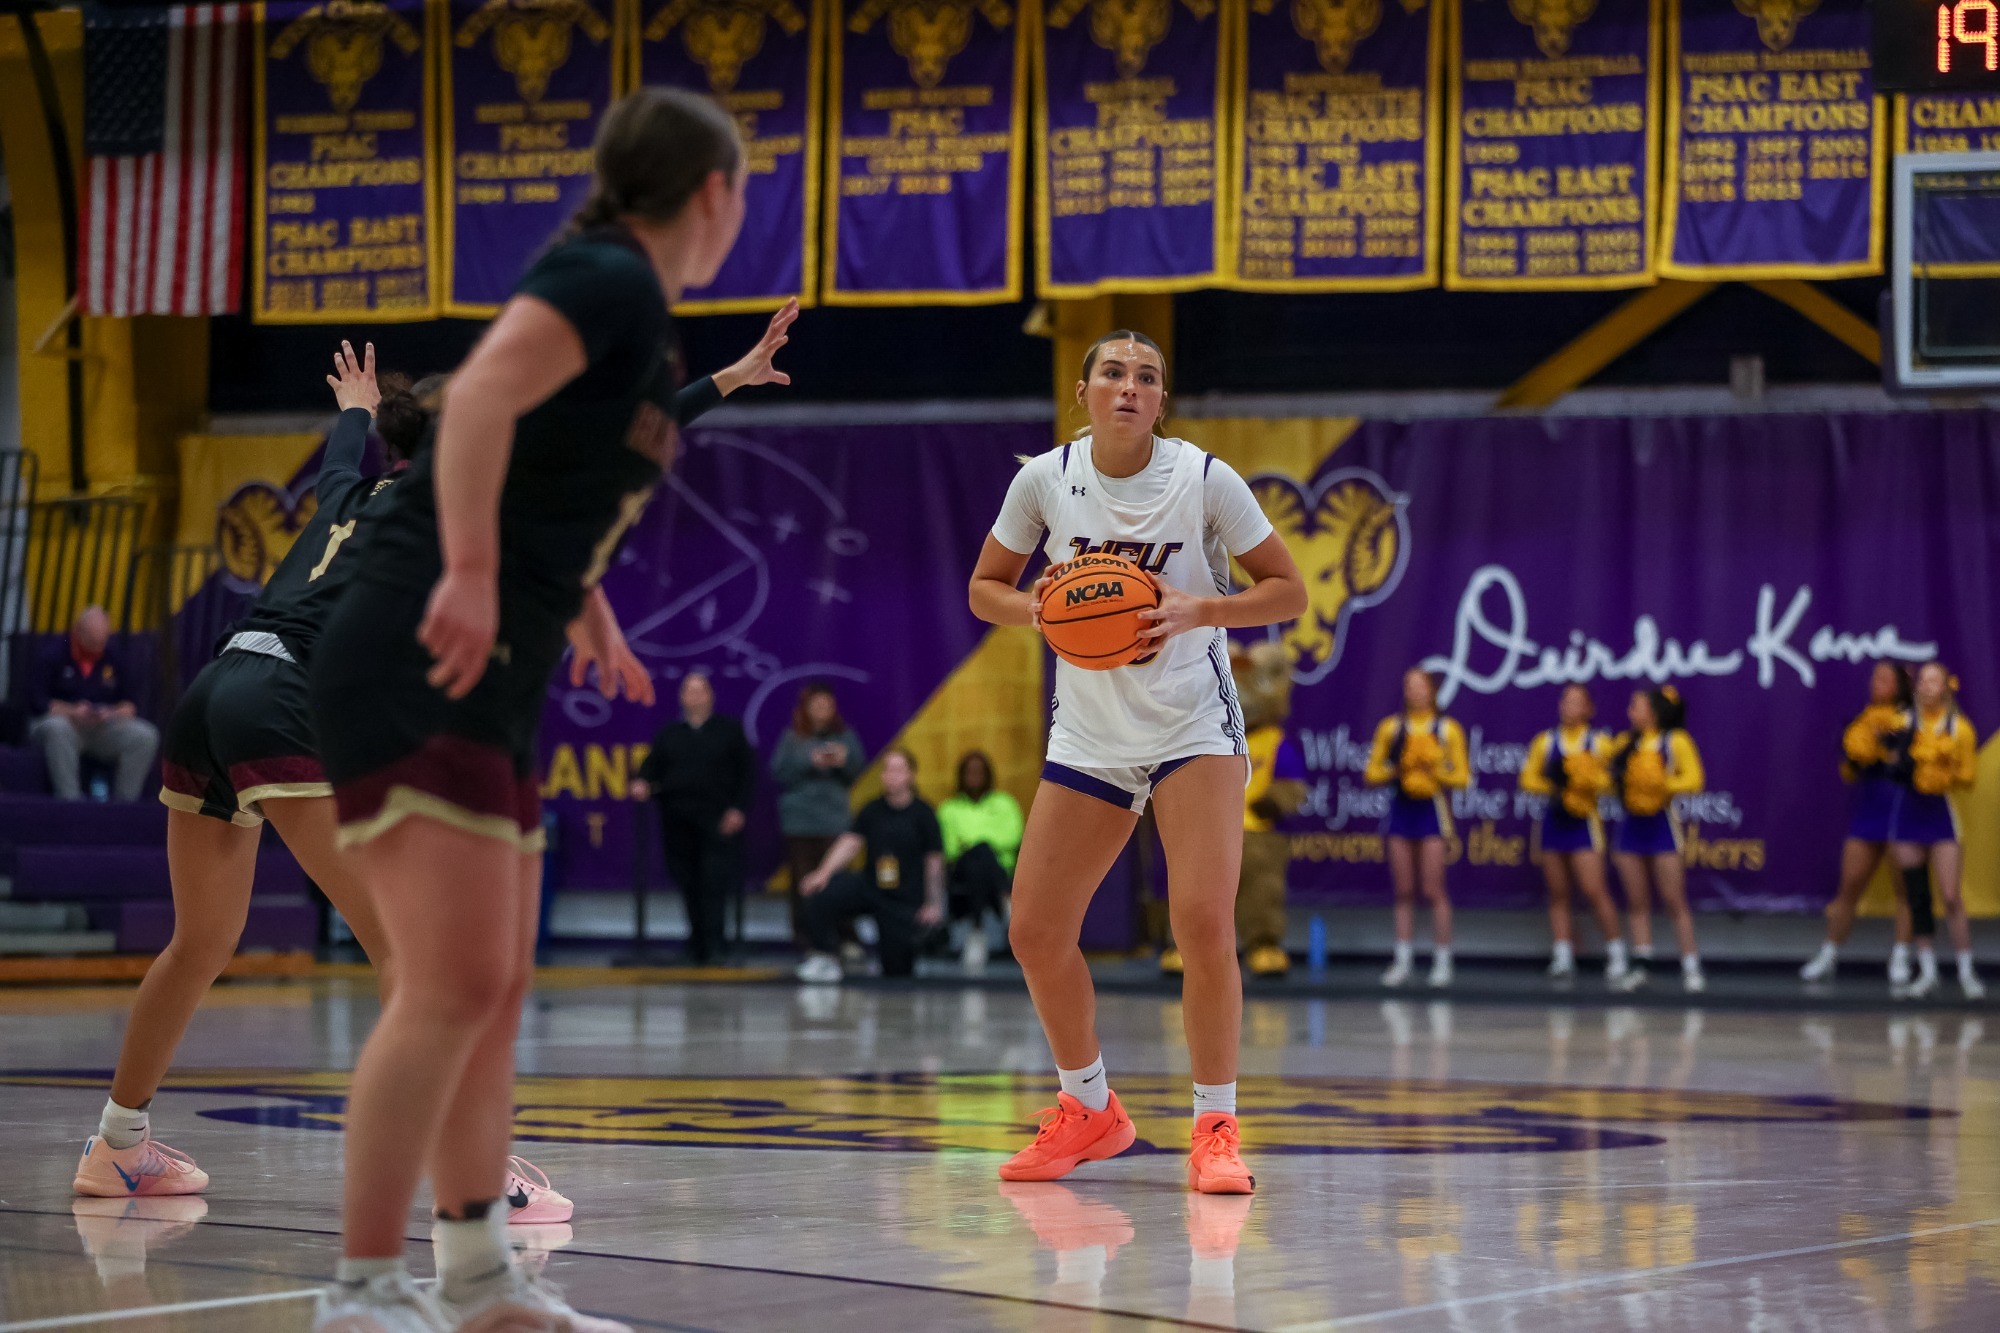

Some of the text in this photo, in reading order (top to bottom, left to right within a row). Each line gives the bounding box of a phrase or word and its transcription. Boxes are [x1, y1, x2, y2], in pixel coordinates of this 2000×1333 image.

[1937, 0, 1998, 72] 19
[1690, 72, 1862, 102] PSAC EAST
[1464, 105, 1642, 137] CHAMPIONS
[1684, 103, 1868, 132] CHAMPIONS
[1339, 162, 1421, 191] EAST
[1469, 165, 1634, 197] PSAC EAST
[1463, 198, 1642, 228] CHAMPIONS
[1065, 581, 1124, 607] NCAA
[1747, 584, 1938, 689] Kane
[1301, 723, 1372, 772] Wha
[540, 742, 651, 800] AN
[1326, 776, 1394, 831] jus
[1468, 821, 1525, 866] the
